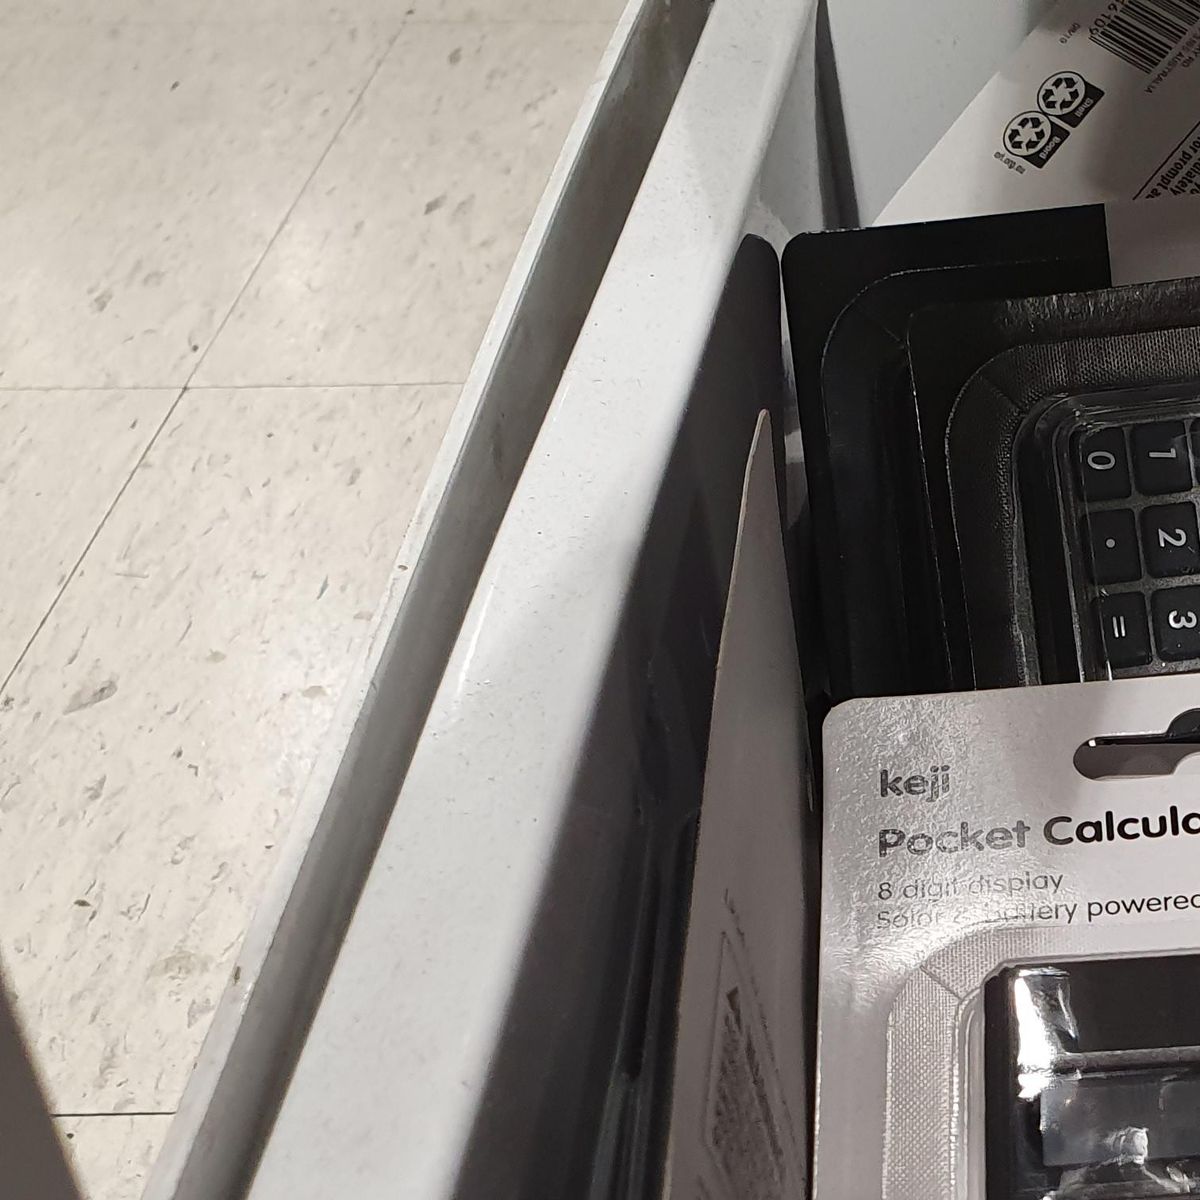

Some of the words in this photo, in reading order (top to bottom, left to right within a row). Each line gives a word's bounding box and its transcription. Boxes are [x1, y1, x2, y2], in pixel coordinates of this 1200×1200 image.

[1156, 150, 1192, 190] prompt
[1148, 447, 1176, 461] 1
[1159, 528, 1187, 547] 2
[1169, 609, 1197, 629] 3
[880, 764, 950, 802] keji
[878, 819, 1031, 858] Pocket
[878, 882, 893, 900] 8
[902, 876, 959, 902] digit
[968, 870, 1064, 897] display
